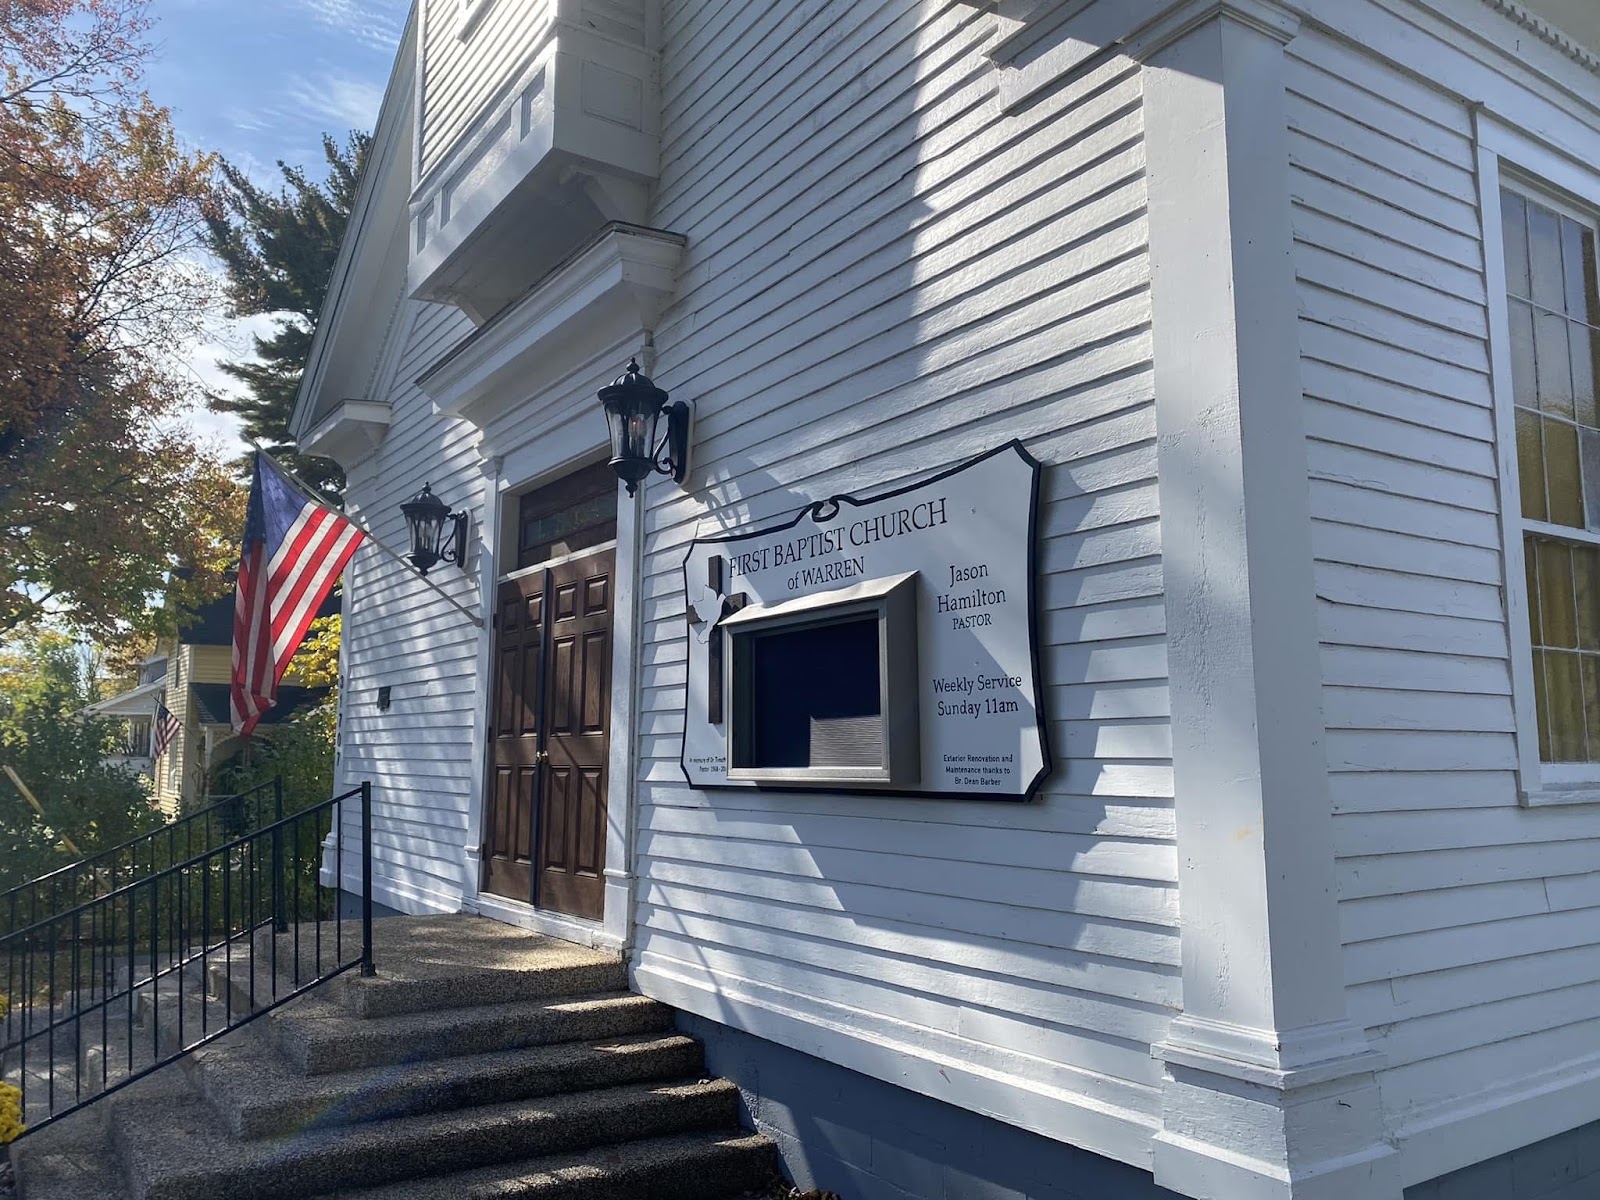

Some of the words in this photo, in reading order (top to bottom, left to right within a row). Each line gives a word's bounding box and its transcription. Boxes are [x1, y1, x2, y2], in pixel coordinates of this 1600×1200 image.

[729, 549, 771, 578] FIRST
[774, 526, 845, 567] BAPTIST
[850, 498, 948, 547] CHURCH
[787, 571, 800, 590] of
[802, 556, 865, 586] WARREN
[949, 564, 988, 588] Jason
[937, 588, 1006, 613] Hamilton
[952, 613, 992, 630] PASTOR
[932, 676, 974, 696] Weekly
[977, 674, 1022, 691] Service
[937, 700, 981, 719] Sunday
[985, 698, 1019, 714] 11am
[943, 754, 966, 762] Exterior
[967, 754, 1000, 763] Renovation
[1001, 753, 1013, 763] and
[945, 766, 981, 774] Maintenance
[982, 766, 1003, 774] thanks
[964, 777, 979, 785] Dean
[980, 777, 1001, 786] Barber
